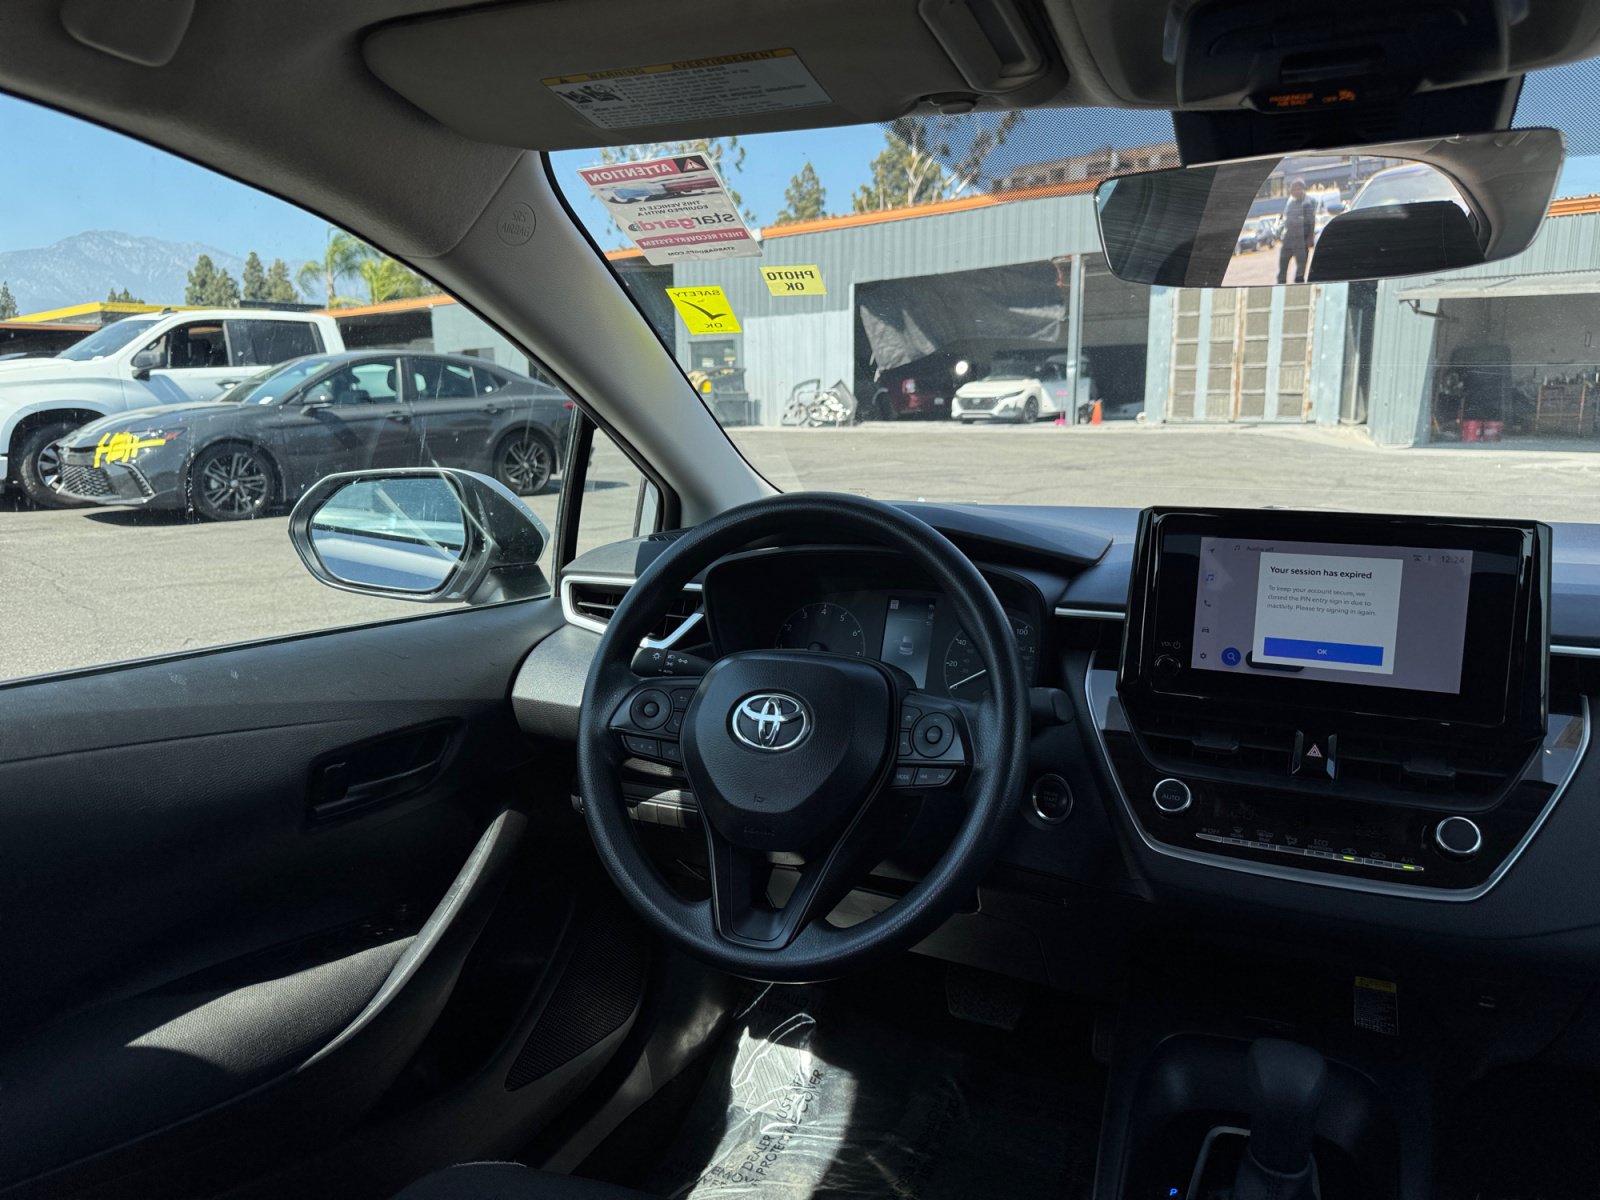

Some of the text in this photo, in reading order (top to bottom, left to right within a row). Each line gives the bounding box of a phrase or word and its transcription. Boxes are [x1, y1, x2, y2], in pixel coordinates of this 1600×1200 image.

[1270, 566, 1373, 579] Your session has expired
[801, 1069, 823, 1113] COVER
[742, 1135, 774, 1172] DEALER
[1169, 1187, 1179, 1197] P
